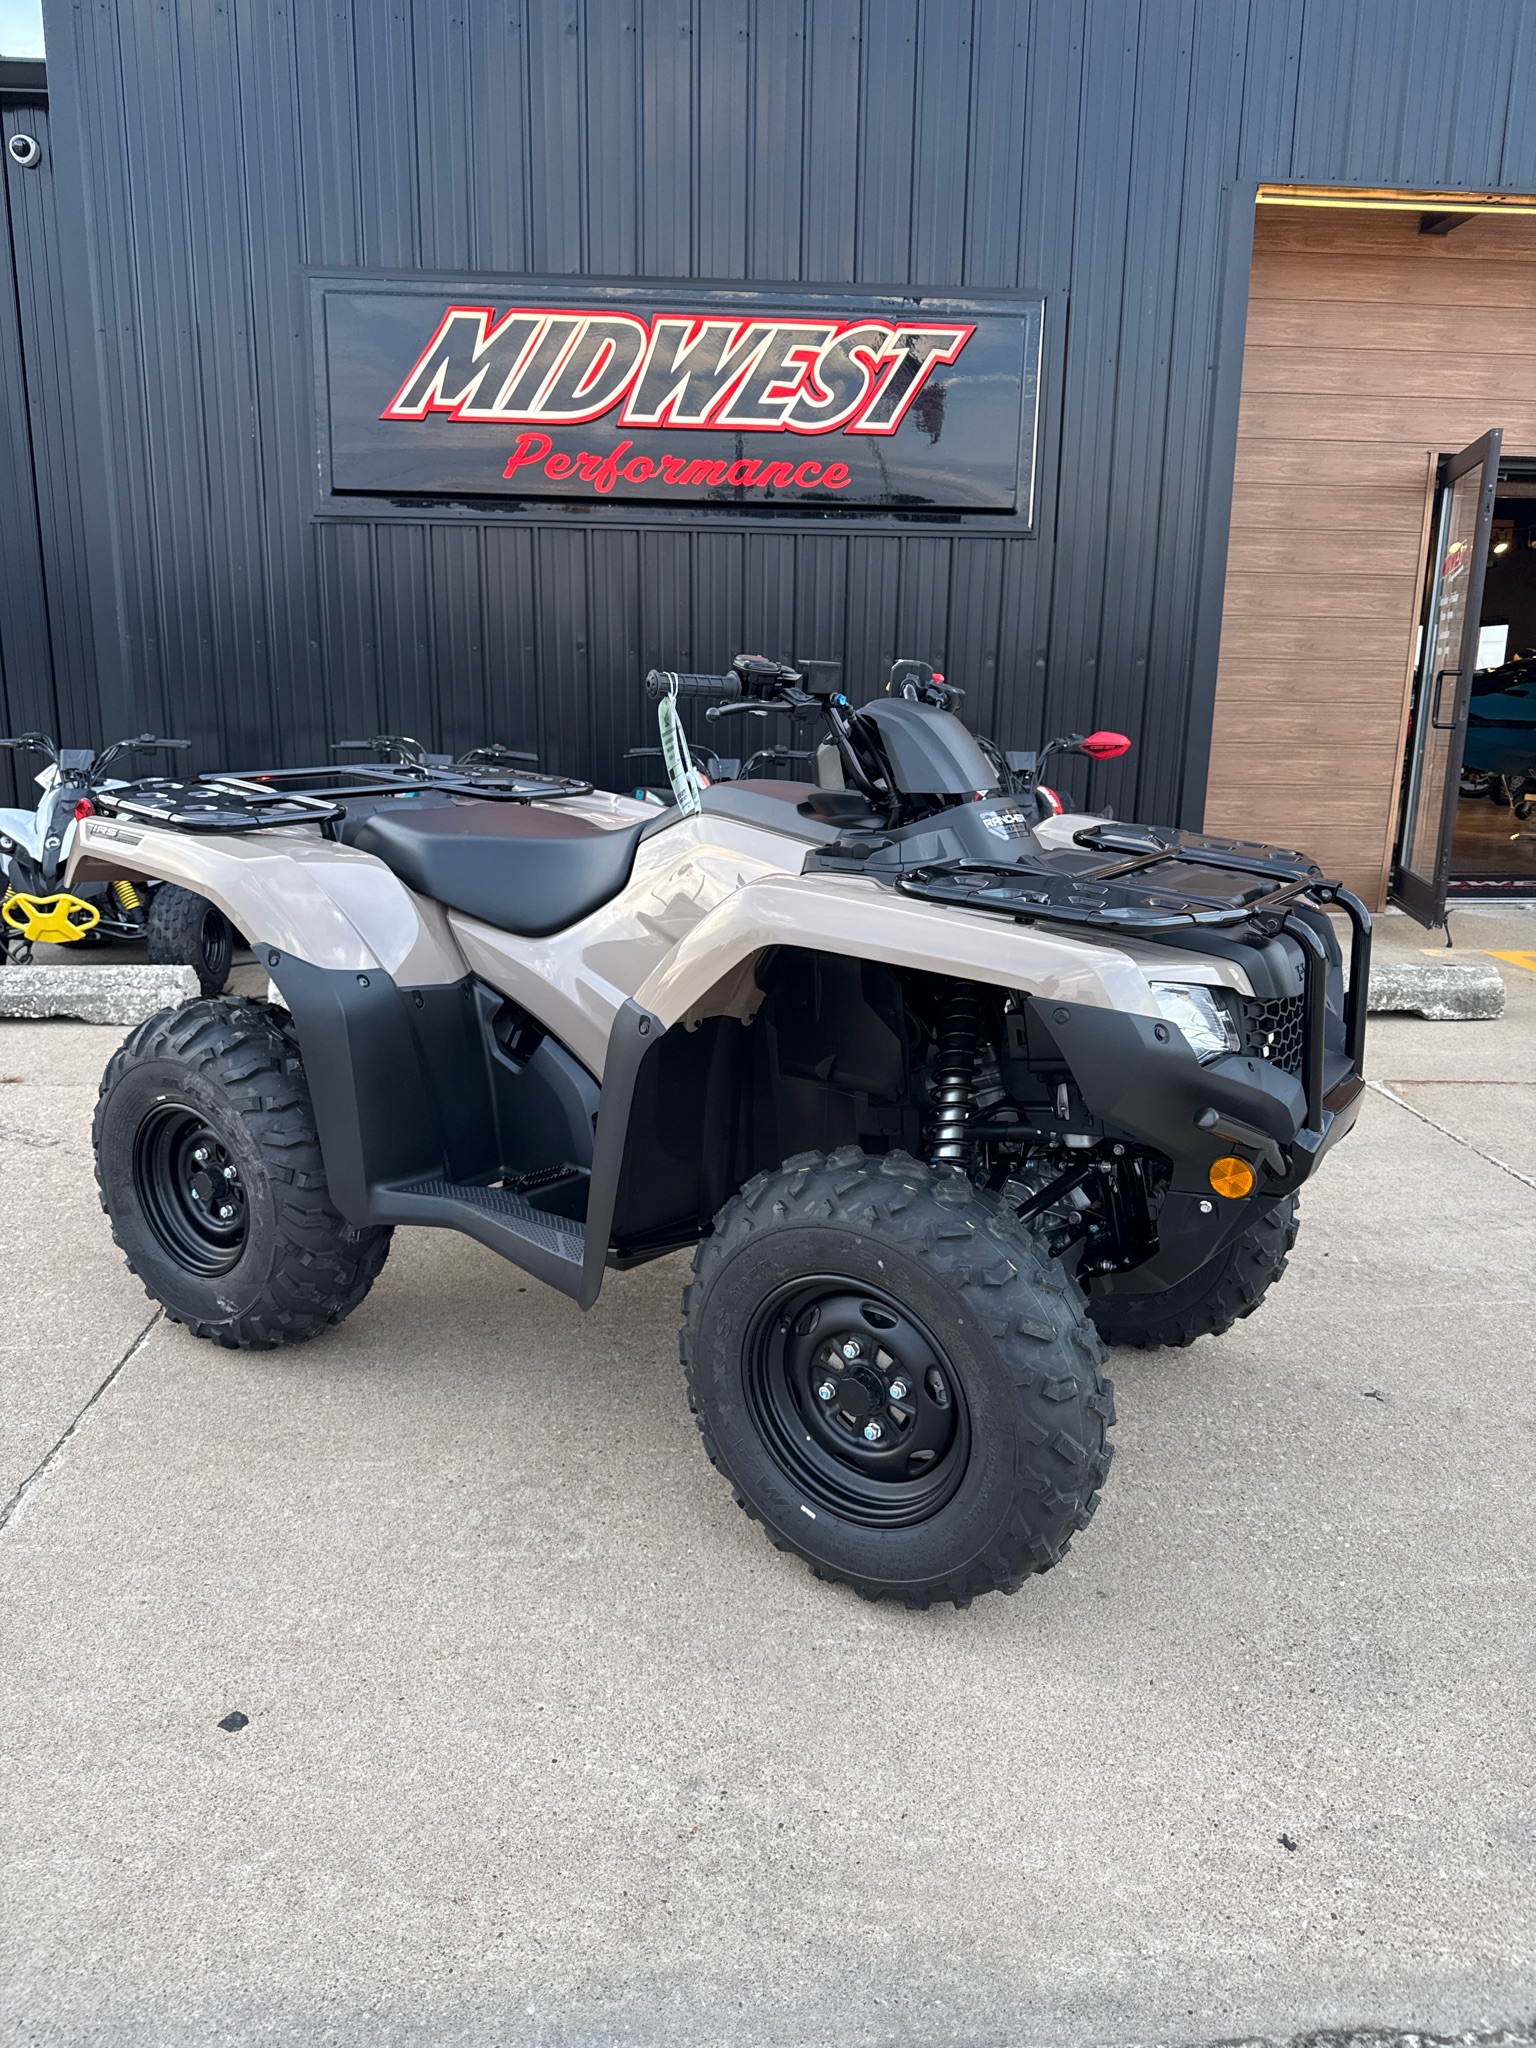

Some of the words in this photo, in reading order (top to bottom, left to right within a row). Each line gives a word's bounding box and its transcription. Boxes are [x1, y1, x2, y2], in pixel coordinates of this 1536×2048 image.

[380, 305, 976, 435] MIDWEST
[502, 432, 853, 493] Performance
[982, 813, 1027, 829] RANCHER
